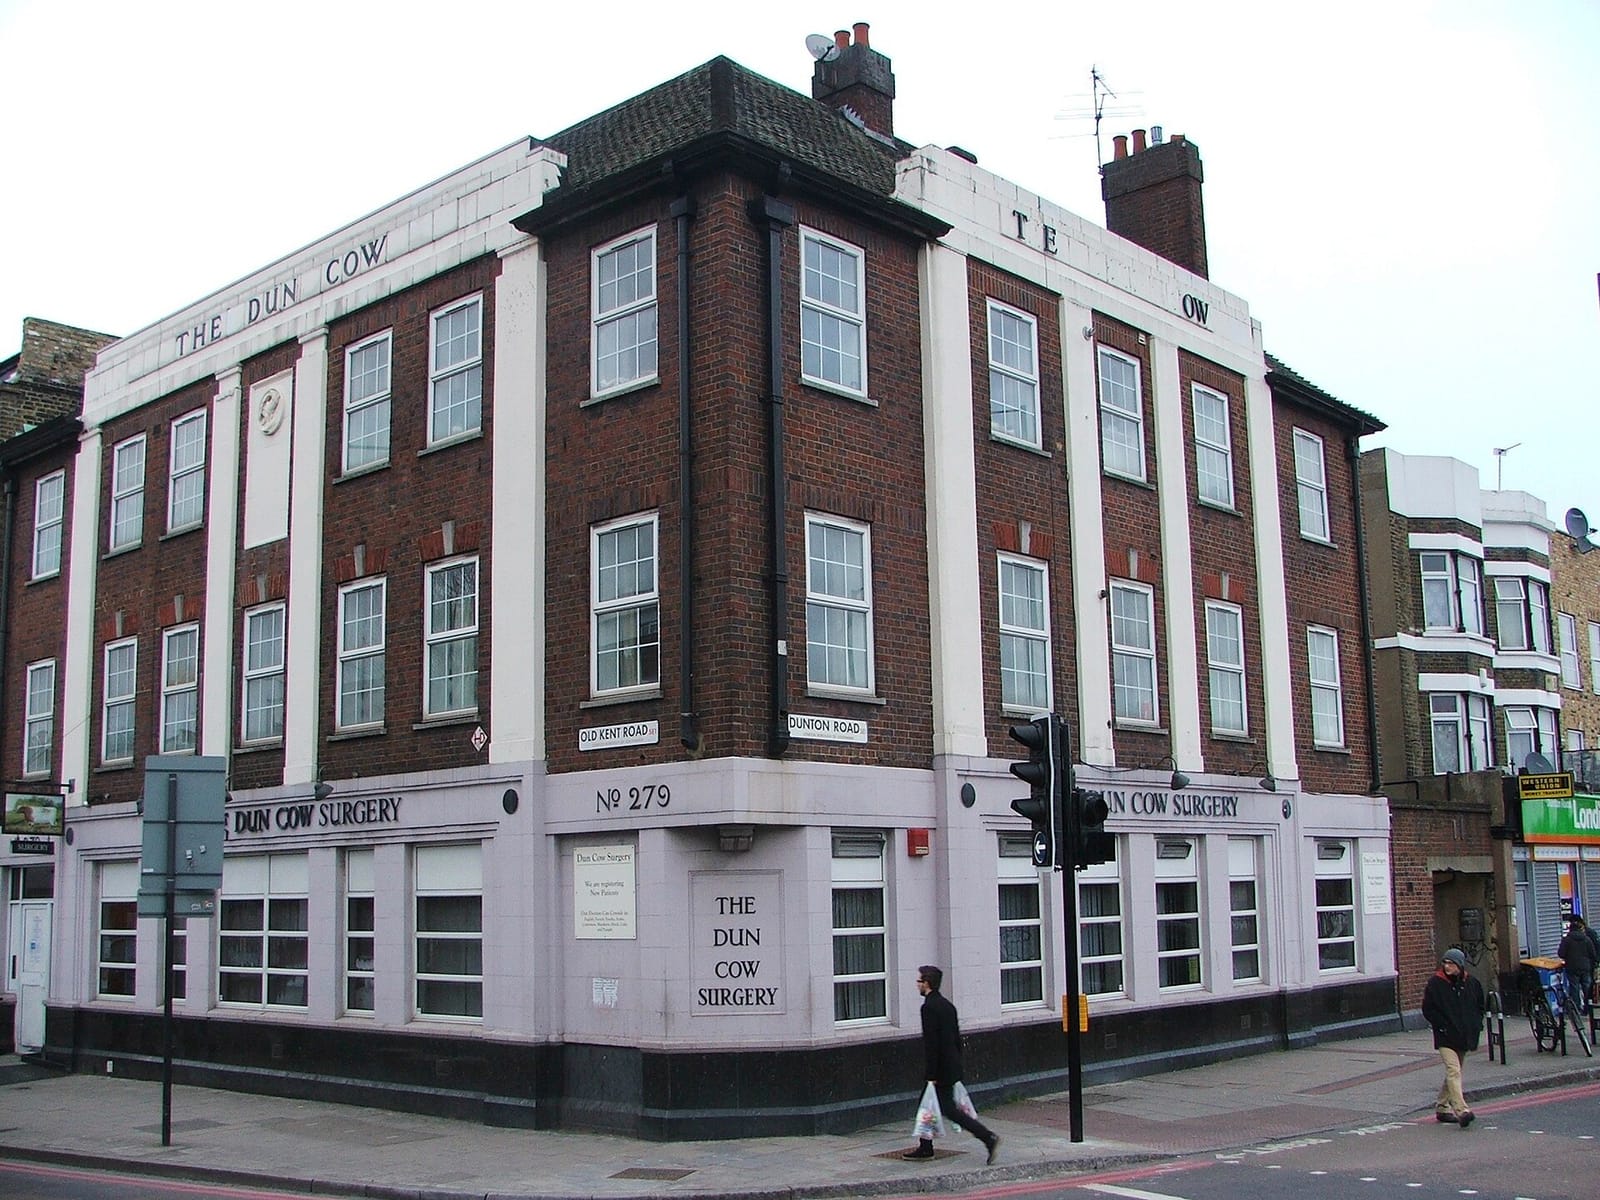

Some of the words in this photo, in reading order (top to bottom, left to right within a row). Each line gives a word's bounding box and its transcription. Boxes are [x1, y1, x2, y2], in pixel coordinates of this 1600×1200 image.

[175, 315, 223, 356] THE
[247, 278, 297, 324] DUN
[326, 234, 388, 285] COW
[580, 730, 597, 742] OLD
[600, 727, 620, 740] KENT
[623, 724, 648, 738] ROAD
[789, 717, 830, 731] DUNTON
[833, 721, 860, 734] ROAD
[1522, 777, 1560, 785] WESTERN
[628, 784, 671, 810] 279
[1131, 791, 1169, 815] COW
[1173, 793, 1239, 817] SURGERY
[234, 808, 272, 834] DUN
[275, 804, 315, 830] COW
[318, 796, 402, 827] SURGERY
[715, 896, 757, 915] THE
[713, 928, 761, 947] DUN
[715, 960, 761, 979] COW
[698, 987, 778, 1006] SURGERY
